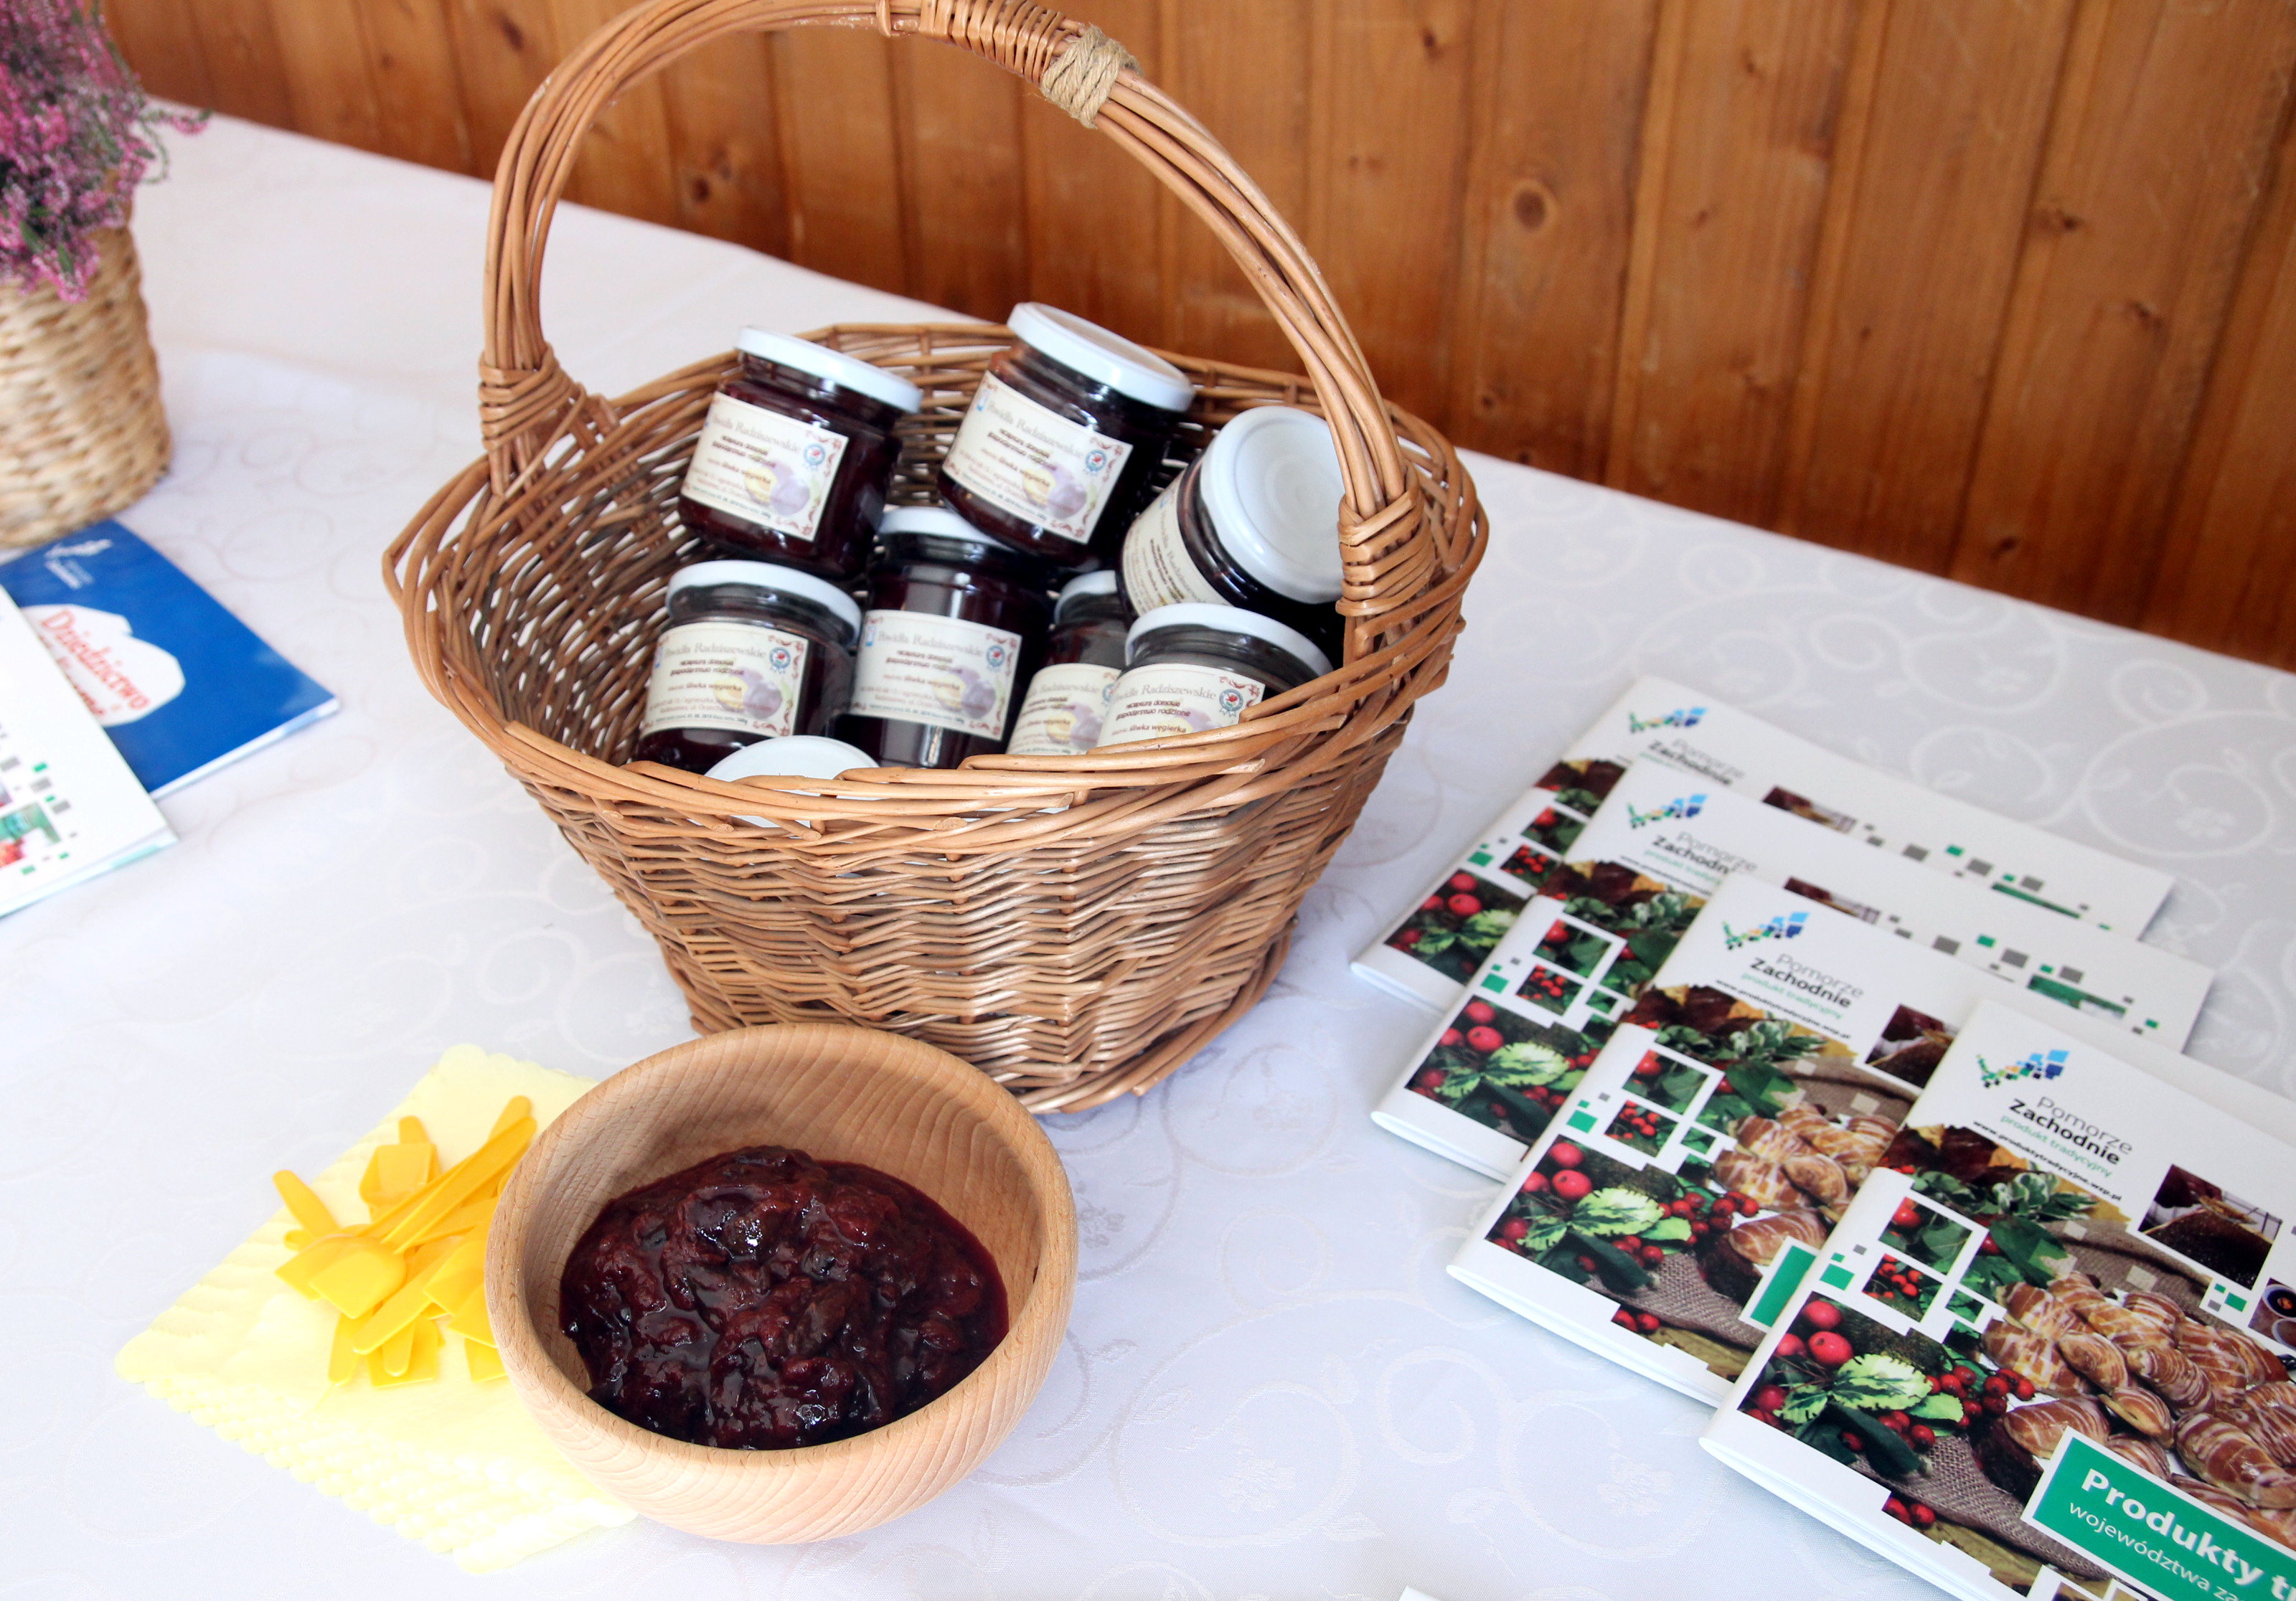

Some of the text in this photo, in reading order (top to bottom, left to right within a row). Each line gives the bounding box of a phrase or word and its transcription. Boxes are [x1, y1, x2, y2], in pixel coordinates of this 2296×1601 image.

[1142, 683, 1217, 699] Radziszewskie
[1152, 724, 1186, 733] węgierka
[1652, 834, 1730, 874] Zachodn
[1749, 957, 1853, 1009] Zachodnie
[1775, 953, 1865, 998] Pomorze
[2000, 1114, 2113, 1179] produkt tradycyjny
[2008, 1098, 2122, 1166] Zachodnie
[2036, 1095, 2134, 1156] Pomorze
[2069, 1501, 2211, 1592] województwa
[2081, 1468, 2264, 1586] Produkty
